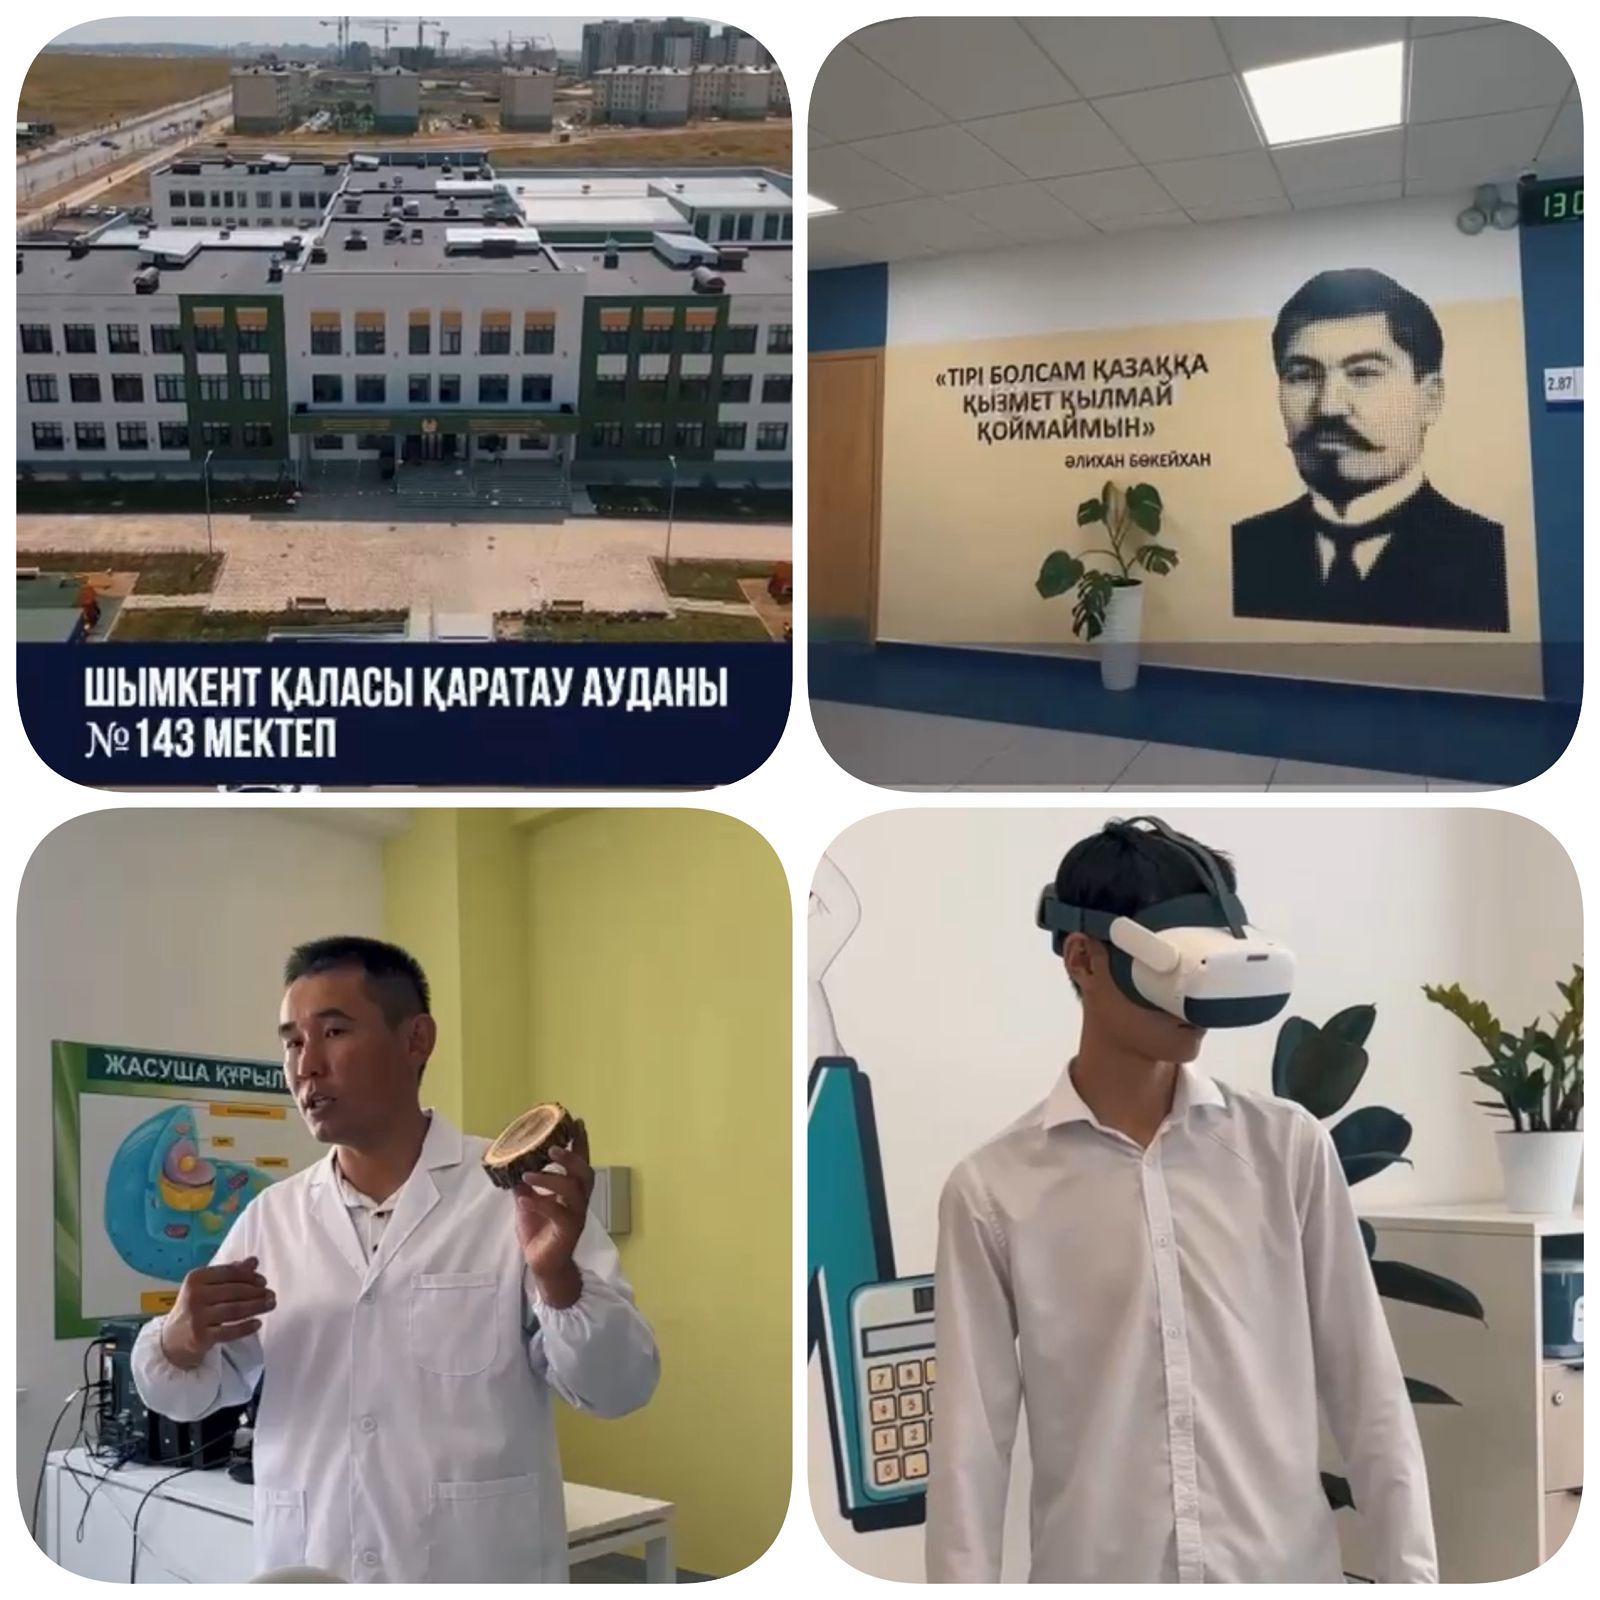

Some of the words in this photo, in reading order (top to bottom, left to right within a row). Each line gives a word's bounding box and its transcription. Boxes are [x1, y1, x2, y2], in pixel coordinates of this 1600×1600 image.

[936, 367, 984, 388] «ТІРІ
[990, 360, 1086, 386] БОЛСАМ
[1093, 353, 1209, 384] ҚАЗАҚҚА
[963, 391, 1053, 415] ҚЫЗМЕТ
[1060, 382, 1173, 416] ҚЫЛМАЙ
[977, 414, 1156, 445] ҚОЙМАЙМЫН»
[1065, 454, 1125, 469] ӘЛИХАН
[1129, 450, 1212, 468] БӨКЕЙХАН
[104, 1053, 210, 1082] ЖАСУША
[878, 1374, 885, 1386] 7
[910, 1429, 918, 1441] 2
